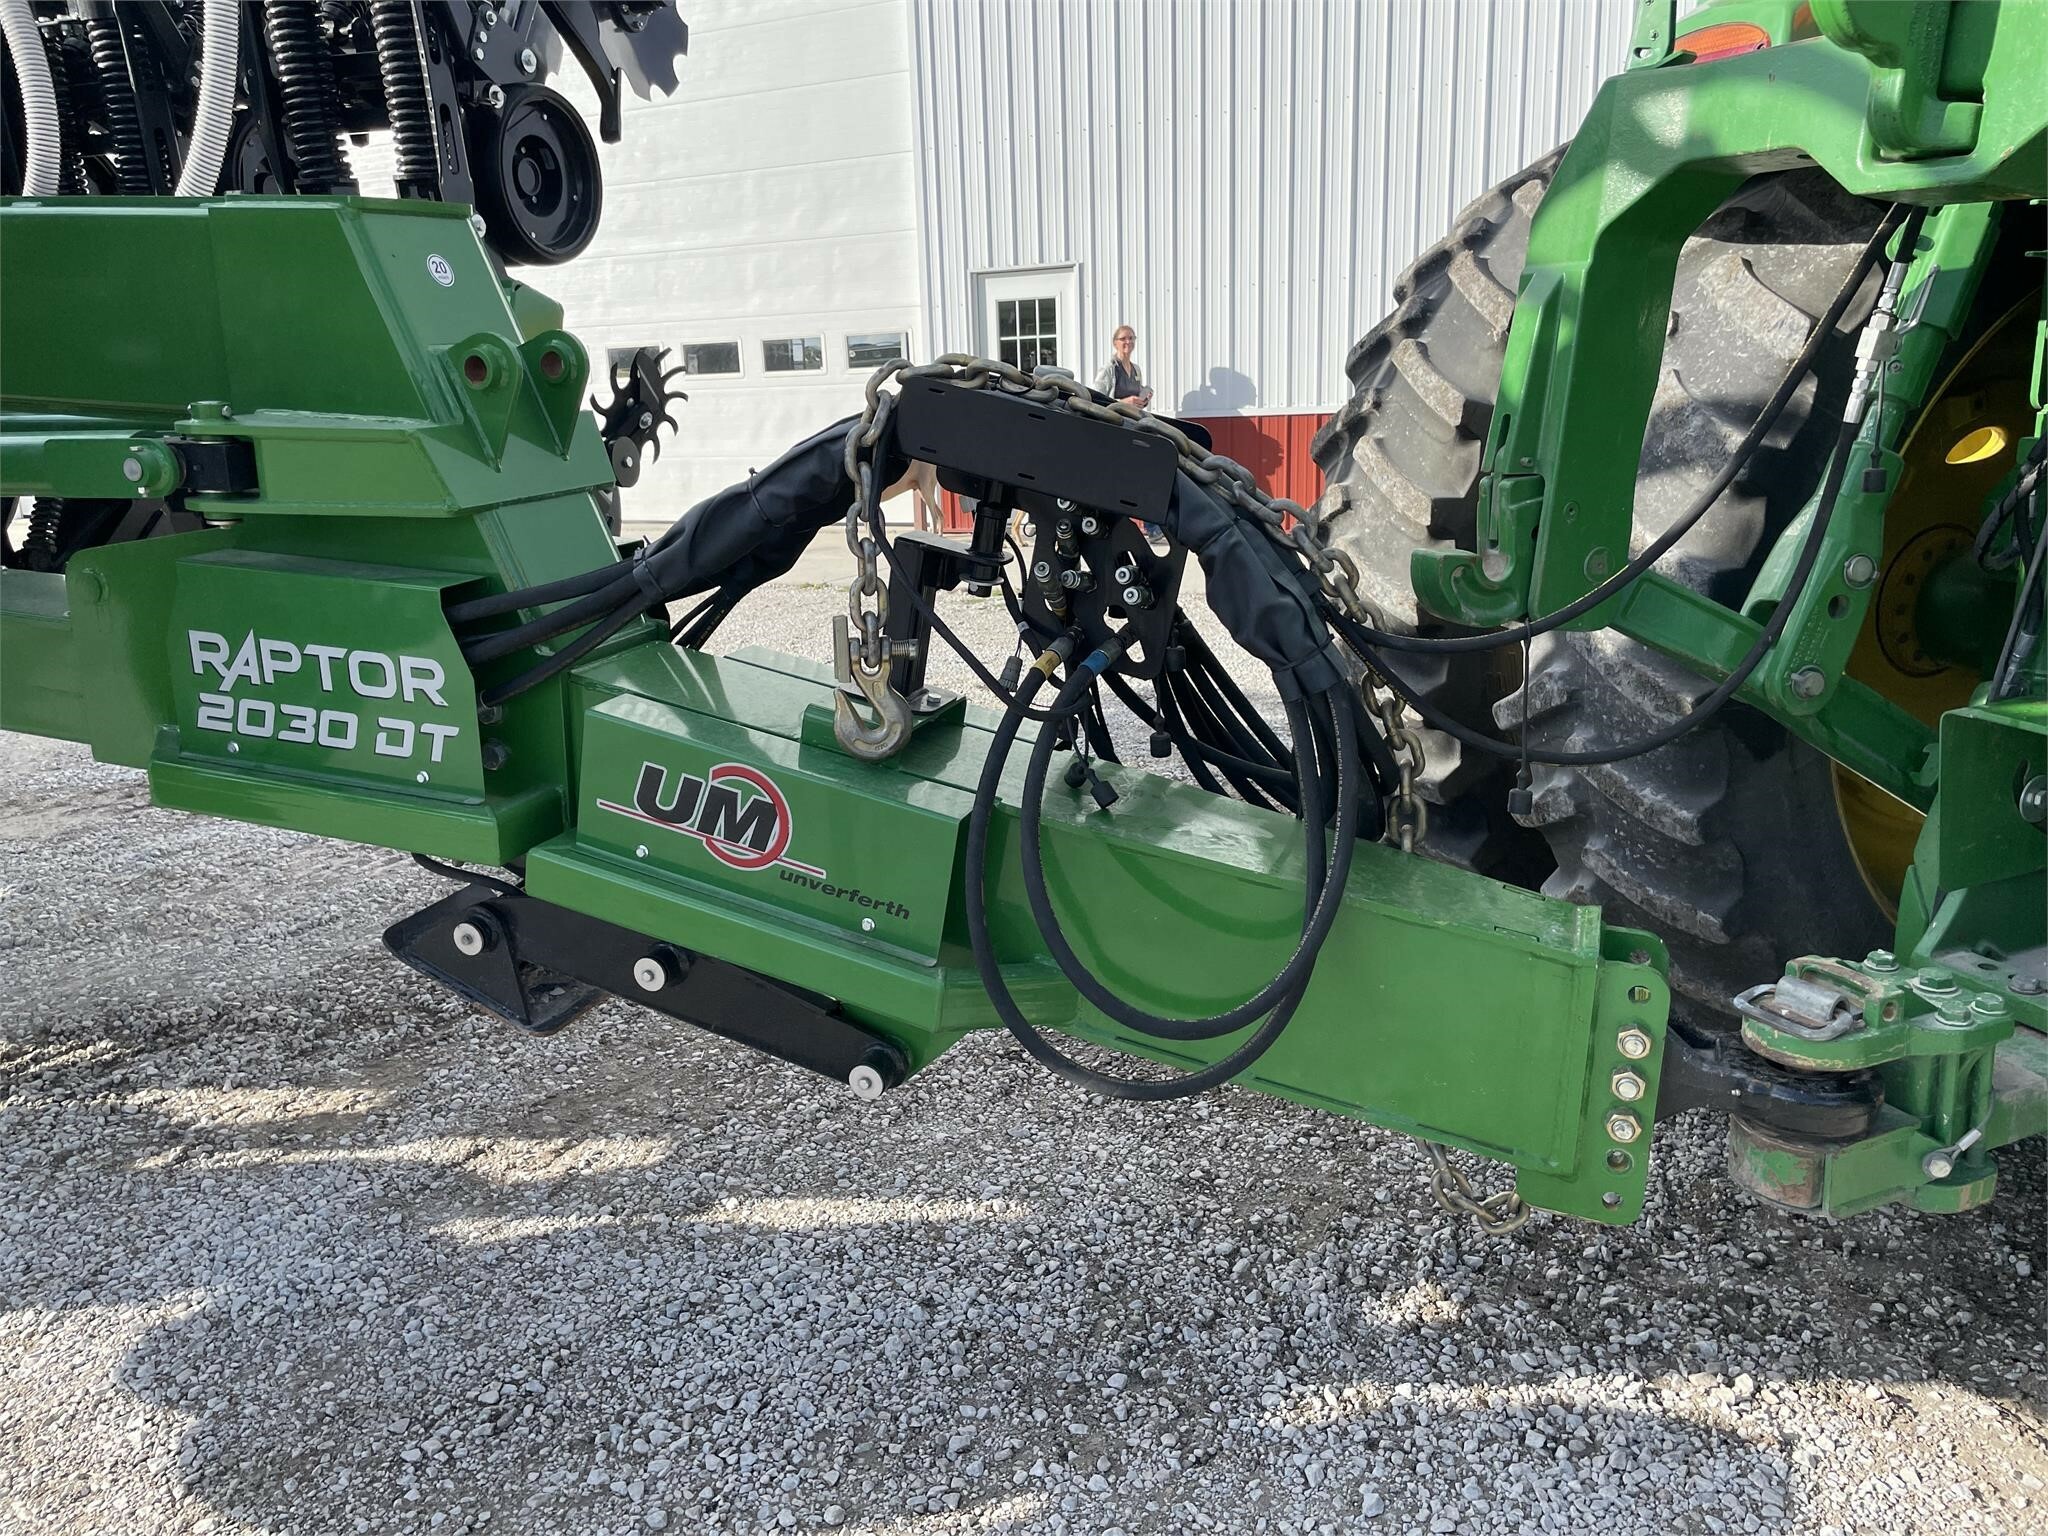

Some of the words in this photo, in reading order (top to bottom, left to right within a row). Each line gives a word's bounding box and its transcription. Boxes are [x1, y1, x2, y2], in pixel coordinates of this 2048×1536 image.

[431, 261, 447, 274] 20
[188, 628, 449, 707] RAPTOR
[197, 693, 359, 750] 2030
[375, 717, 460, 762] DT
[633, 761, 779, 854] UM
[779, 869, 910, 920] unverferth
